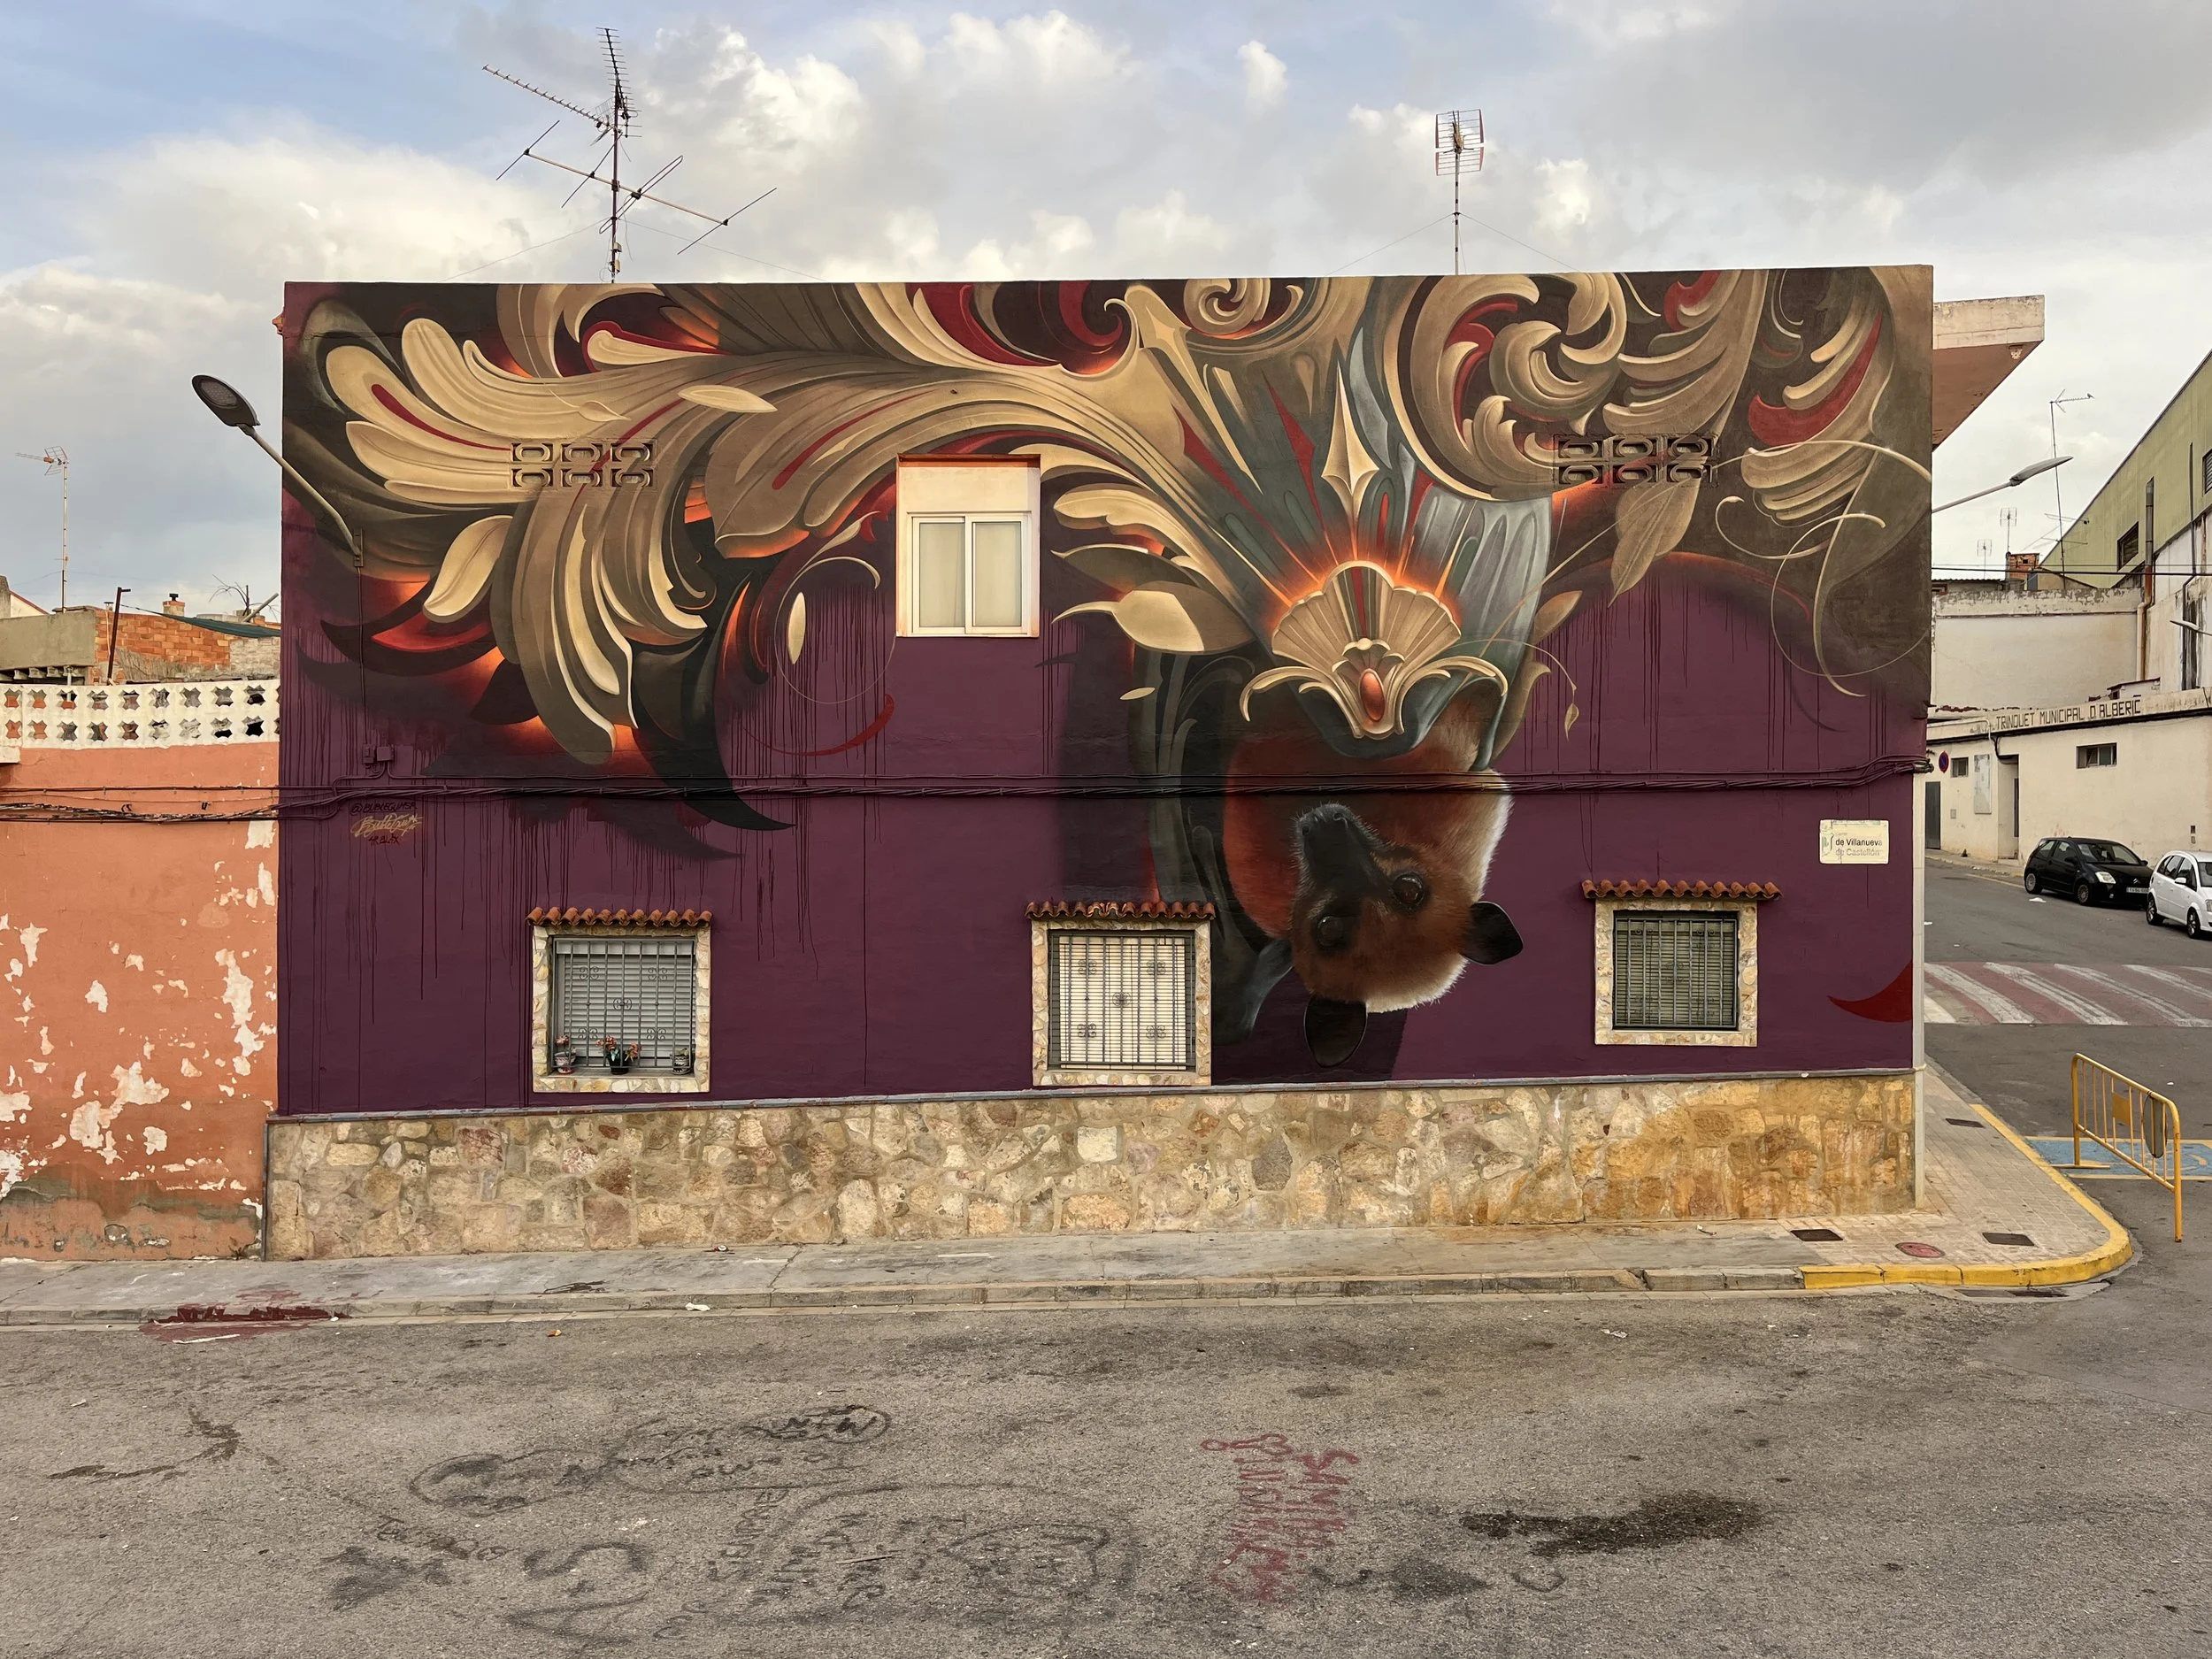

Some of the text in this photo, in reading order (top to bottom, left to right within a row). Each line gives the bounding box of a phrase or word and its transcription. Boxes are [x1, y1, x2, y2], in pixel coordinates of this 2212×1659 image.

[2039, 707, 2084, 725] MUNICIPAL
[1835, 838, 1883, 847] de Villanueva
